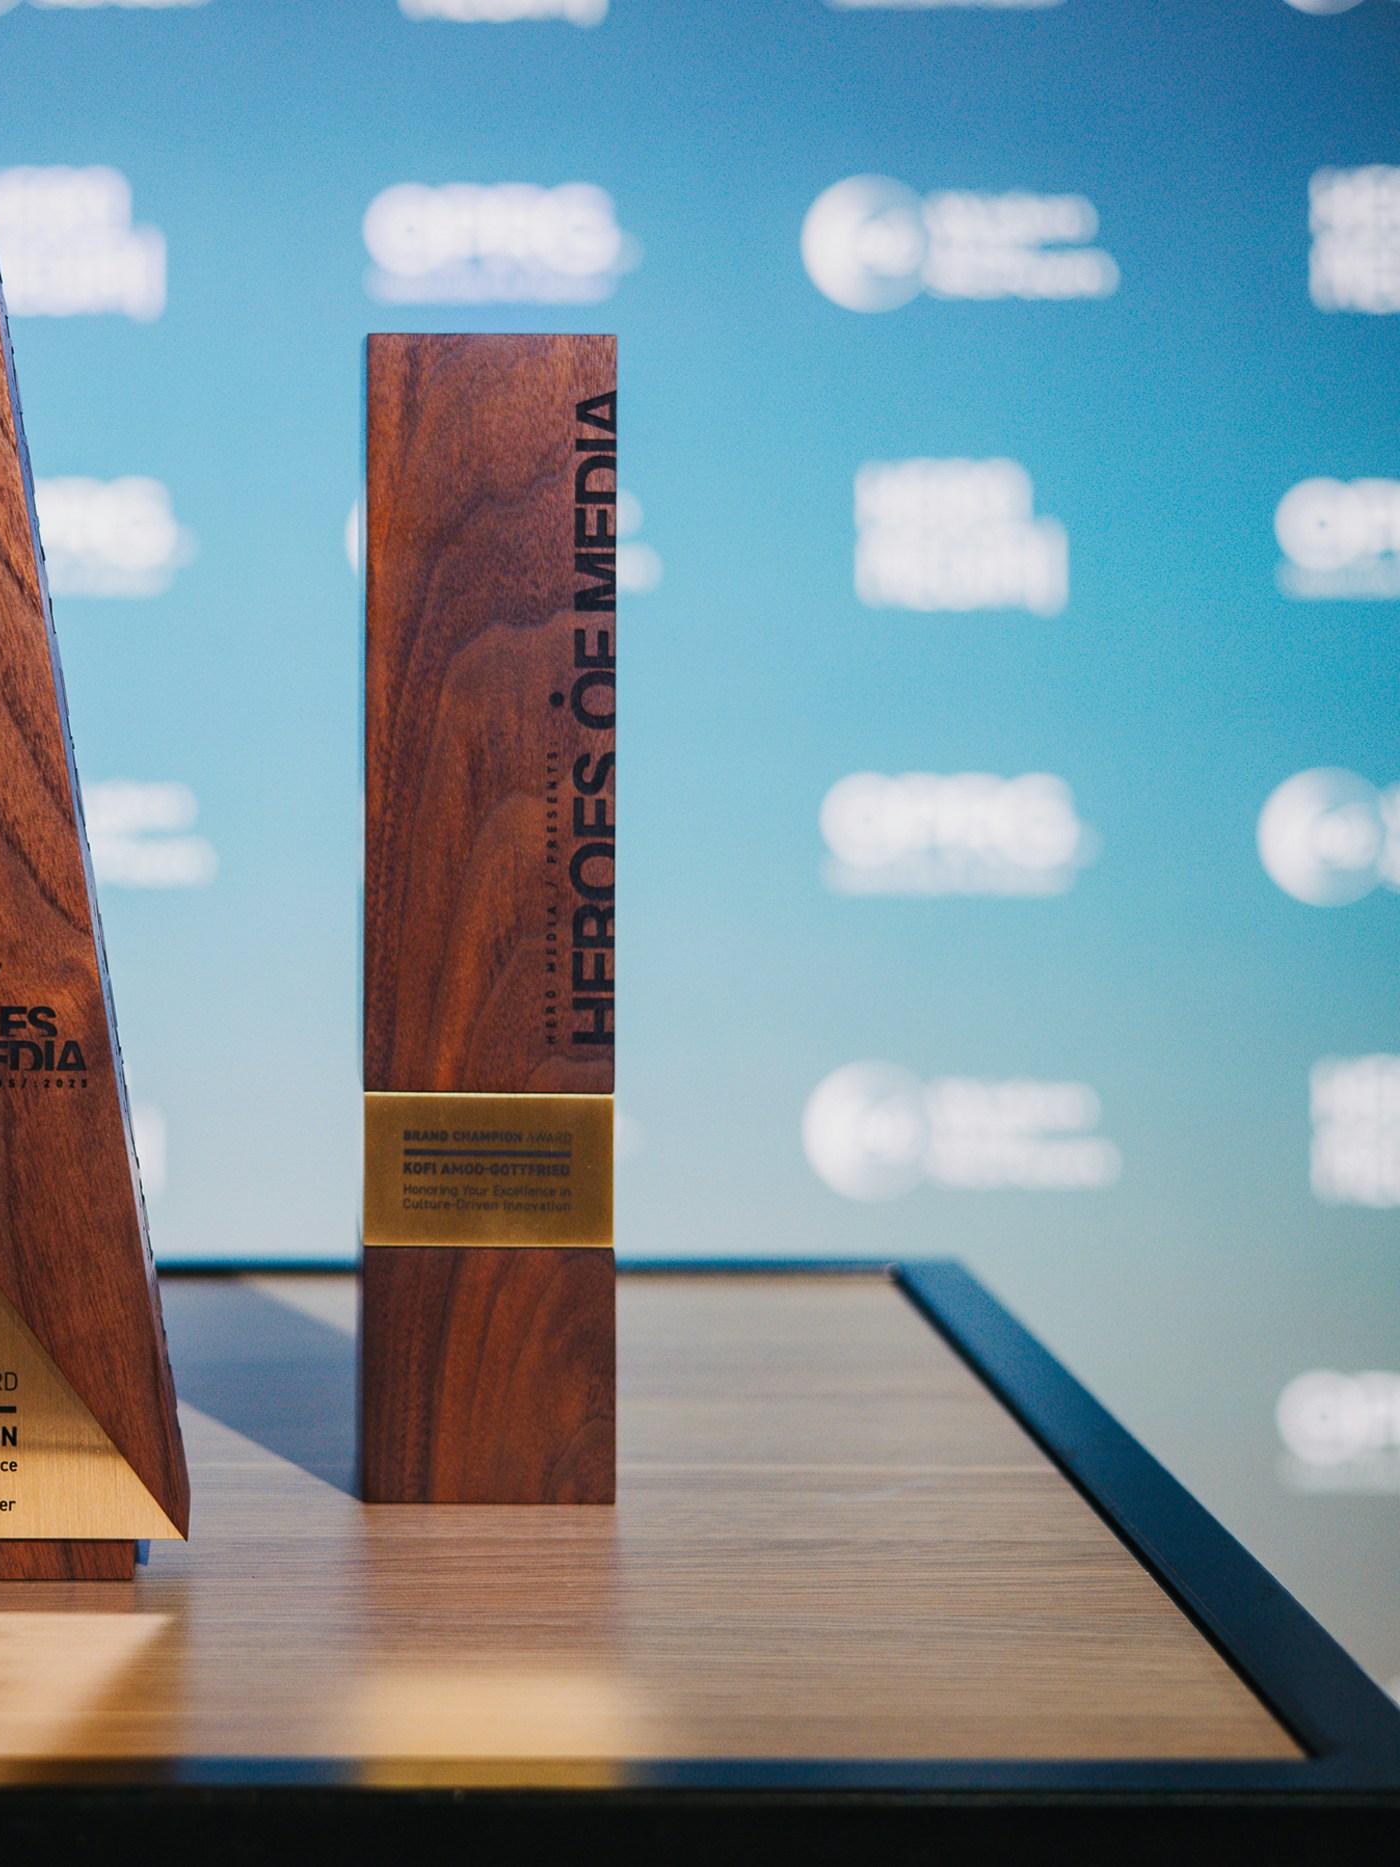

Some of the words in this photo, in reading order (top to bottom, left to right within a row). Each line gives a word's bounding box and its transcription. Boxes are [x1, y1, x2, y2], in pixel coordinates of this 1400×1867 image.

[574, 390, 617, 612] MEDIA
[570, 628, 616, 730] OF
[569, 752, 616, 1045] HEROES
[546, 906, 557, 972] MEDIA
[545, 990, 557, 1044] HERO
[403, 1130, 448, 1142] BRAND
[453, 1130, 522, 1142] CHAMPION
[527, 1132, 572, 1144] AWARD
[403, 1162, 437, 1175] KOFI
[441, 1162, 571, 1177] AMOO-GOTTFRIED
[403, 1184, 458, 1198] Honoring
[462, 1184, 488, 1196] Your
[493, 1184, 556, 1197] Excellence
[560, 1186, 571, 1197] in
[403, 1199, 498, 1211] Culture-Driven
[503, 1200, 571, 1212] Innovation
